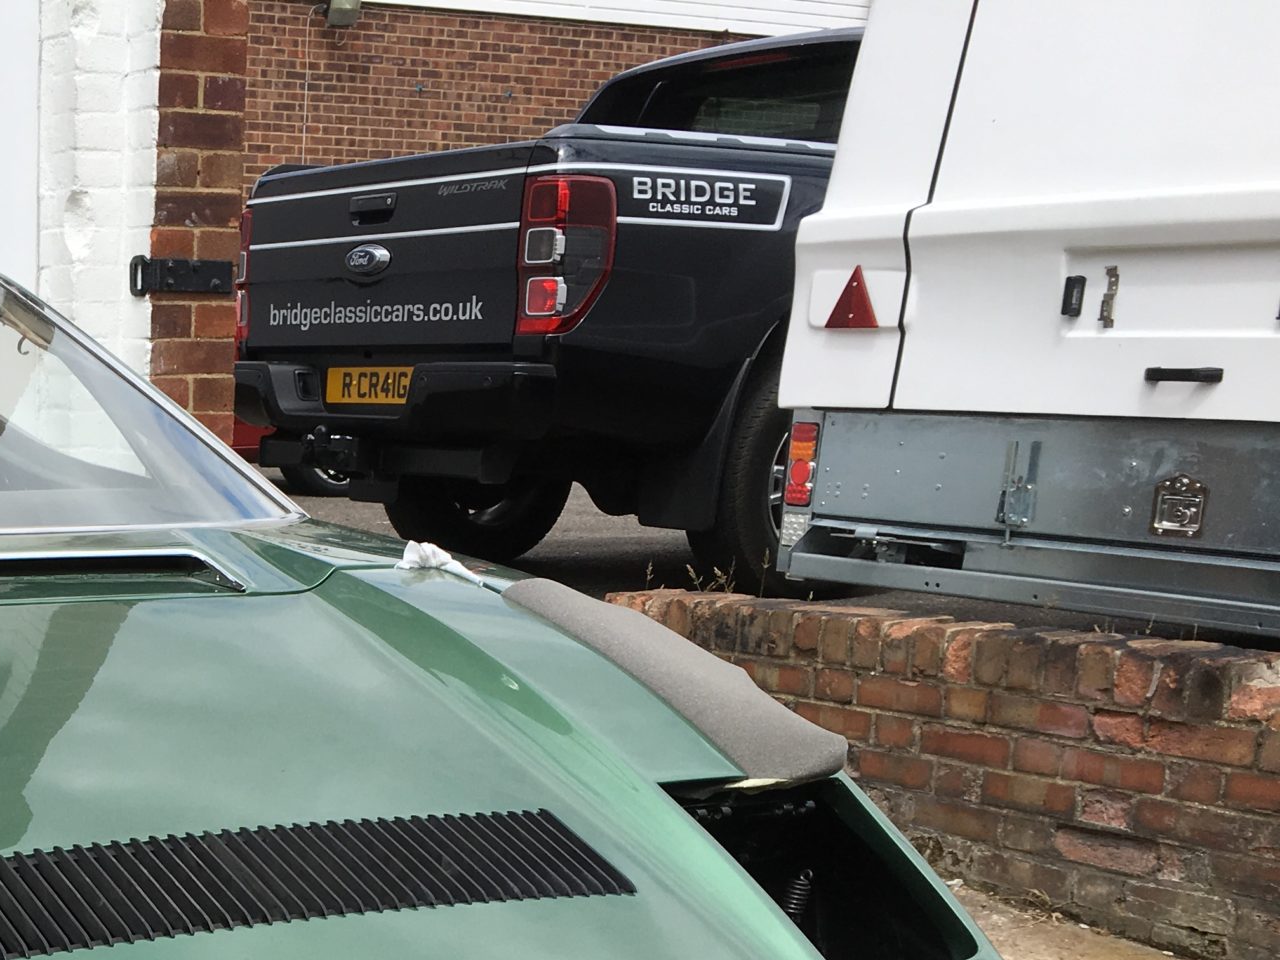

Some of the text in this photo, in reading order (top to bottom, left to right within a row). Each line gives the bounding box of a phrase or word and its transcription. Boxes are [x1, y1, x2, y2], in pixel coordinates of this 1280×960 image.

[437, 179, 508, 196] WILDTRAK
[632, 176, 756, 205] BRIDGE
[648, 203, 738, 216] CLASSIC CARS
[350, 252, 370, 266] Ford
[270, 295, 483, 331] bridgeclassiccars.co.uk
